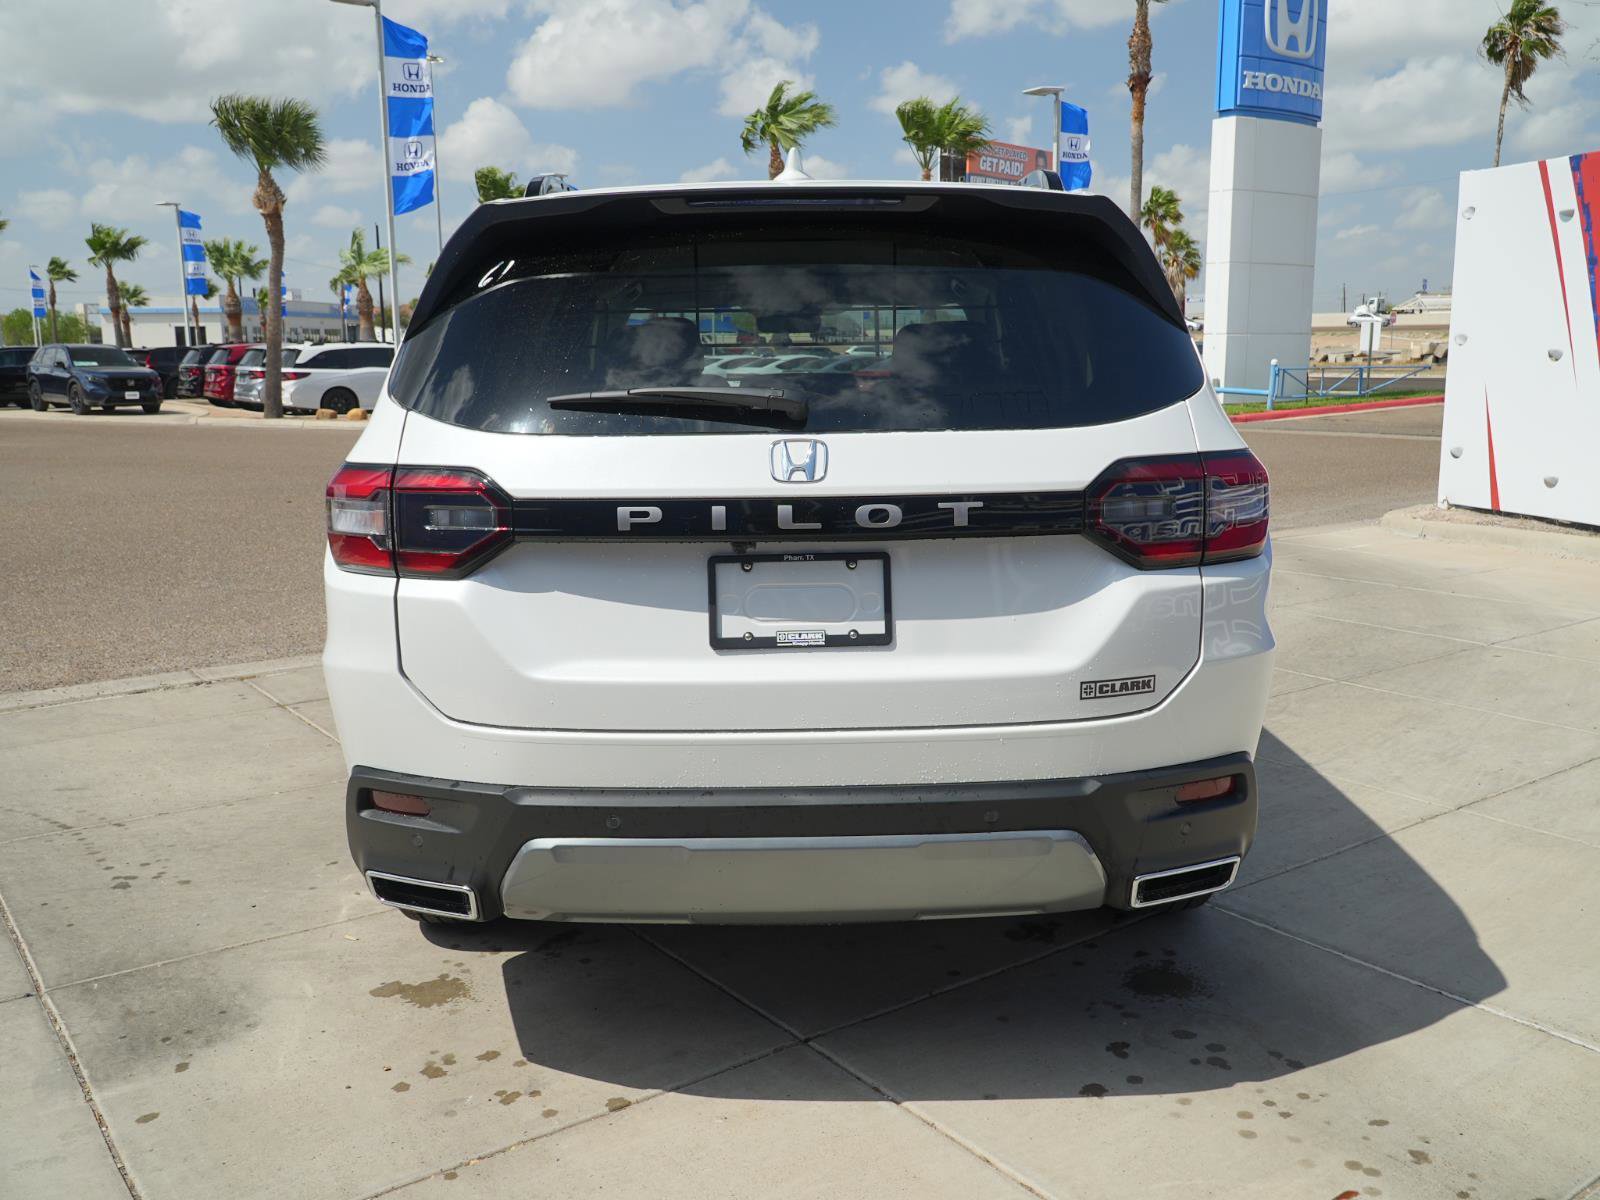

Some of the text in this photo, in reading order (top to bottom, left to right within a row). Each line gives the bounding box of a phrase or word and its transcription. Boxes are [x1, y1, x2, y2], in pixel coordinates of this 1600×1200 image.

[1242, 70, 1323, 100] HONDA
[1062, 151, 1088, 159] HONDA
[980, 155, 1024, 176] GET PAID!
[617, 501, 984, 531] PILOT
[787, 632, 823, 640] CLARK
[1098, 679, 1153, 694] CLARK
